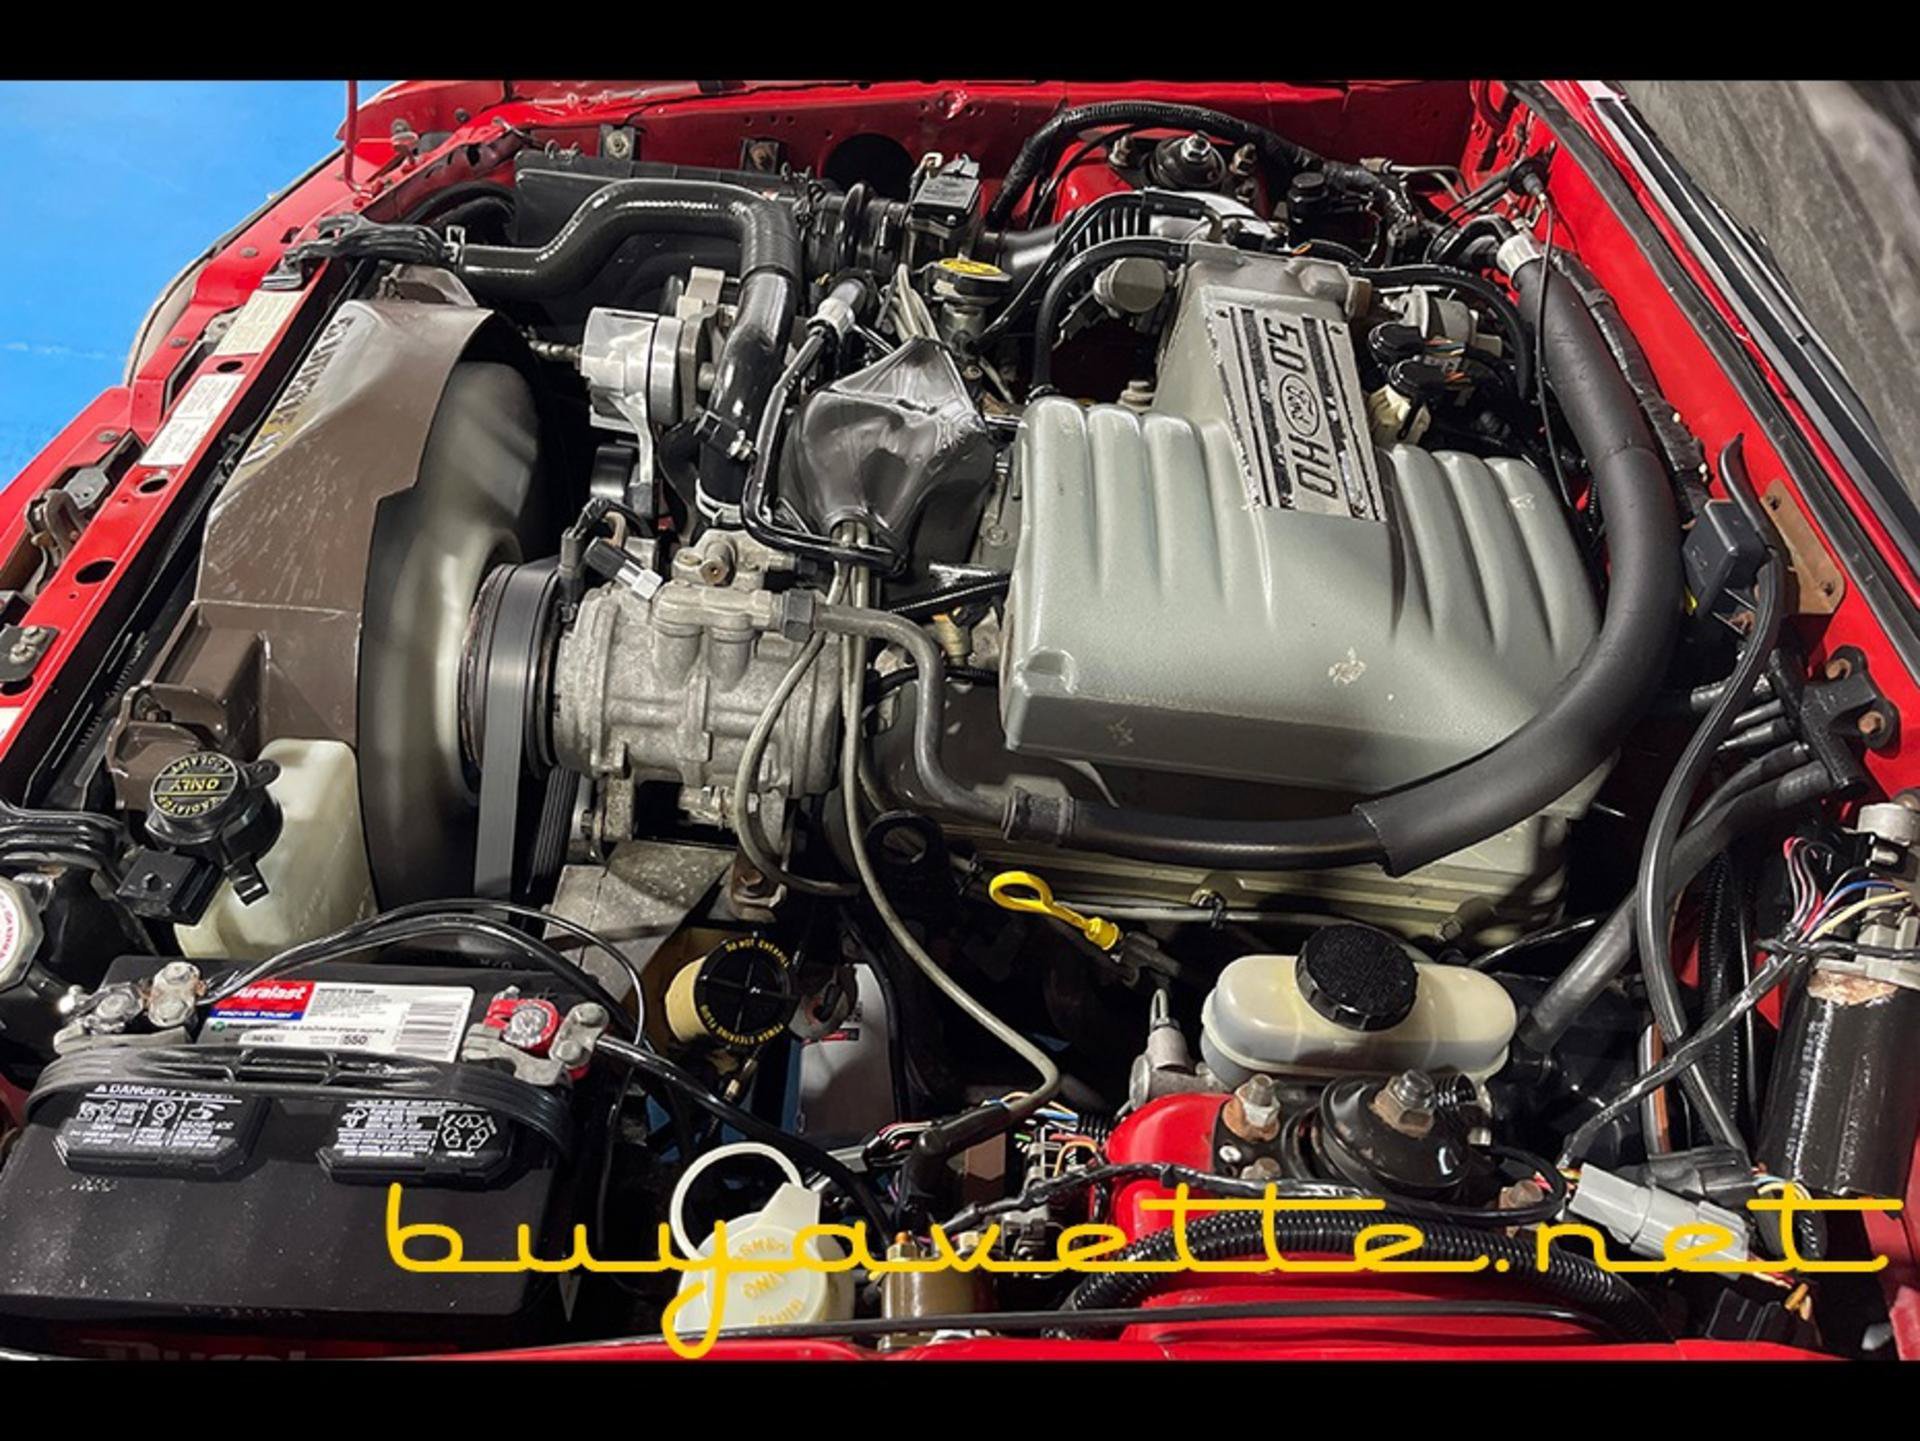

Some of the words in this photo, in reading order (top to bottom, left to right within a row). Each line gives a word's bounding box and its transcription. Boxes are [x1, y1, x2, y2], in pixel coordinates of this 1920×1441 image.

[1264, 317, 1308, 374] 5.0
[1288, 434, 1339, 500] HO
[170, 777, 220, 792] ONLY
[231, 986, 307, 1000] uralast
